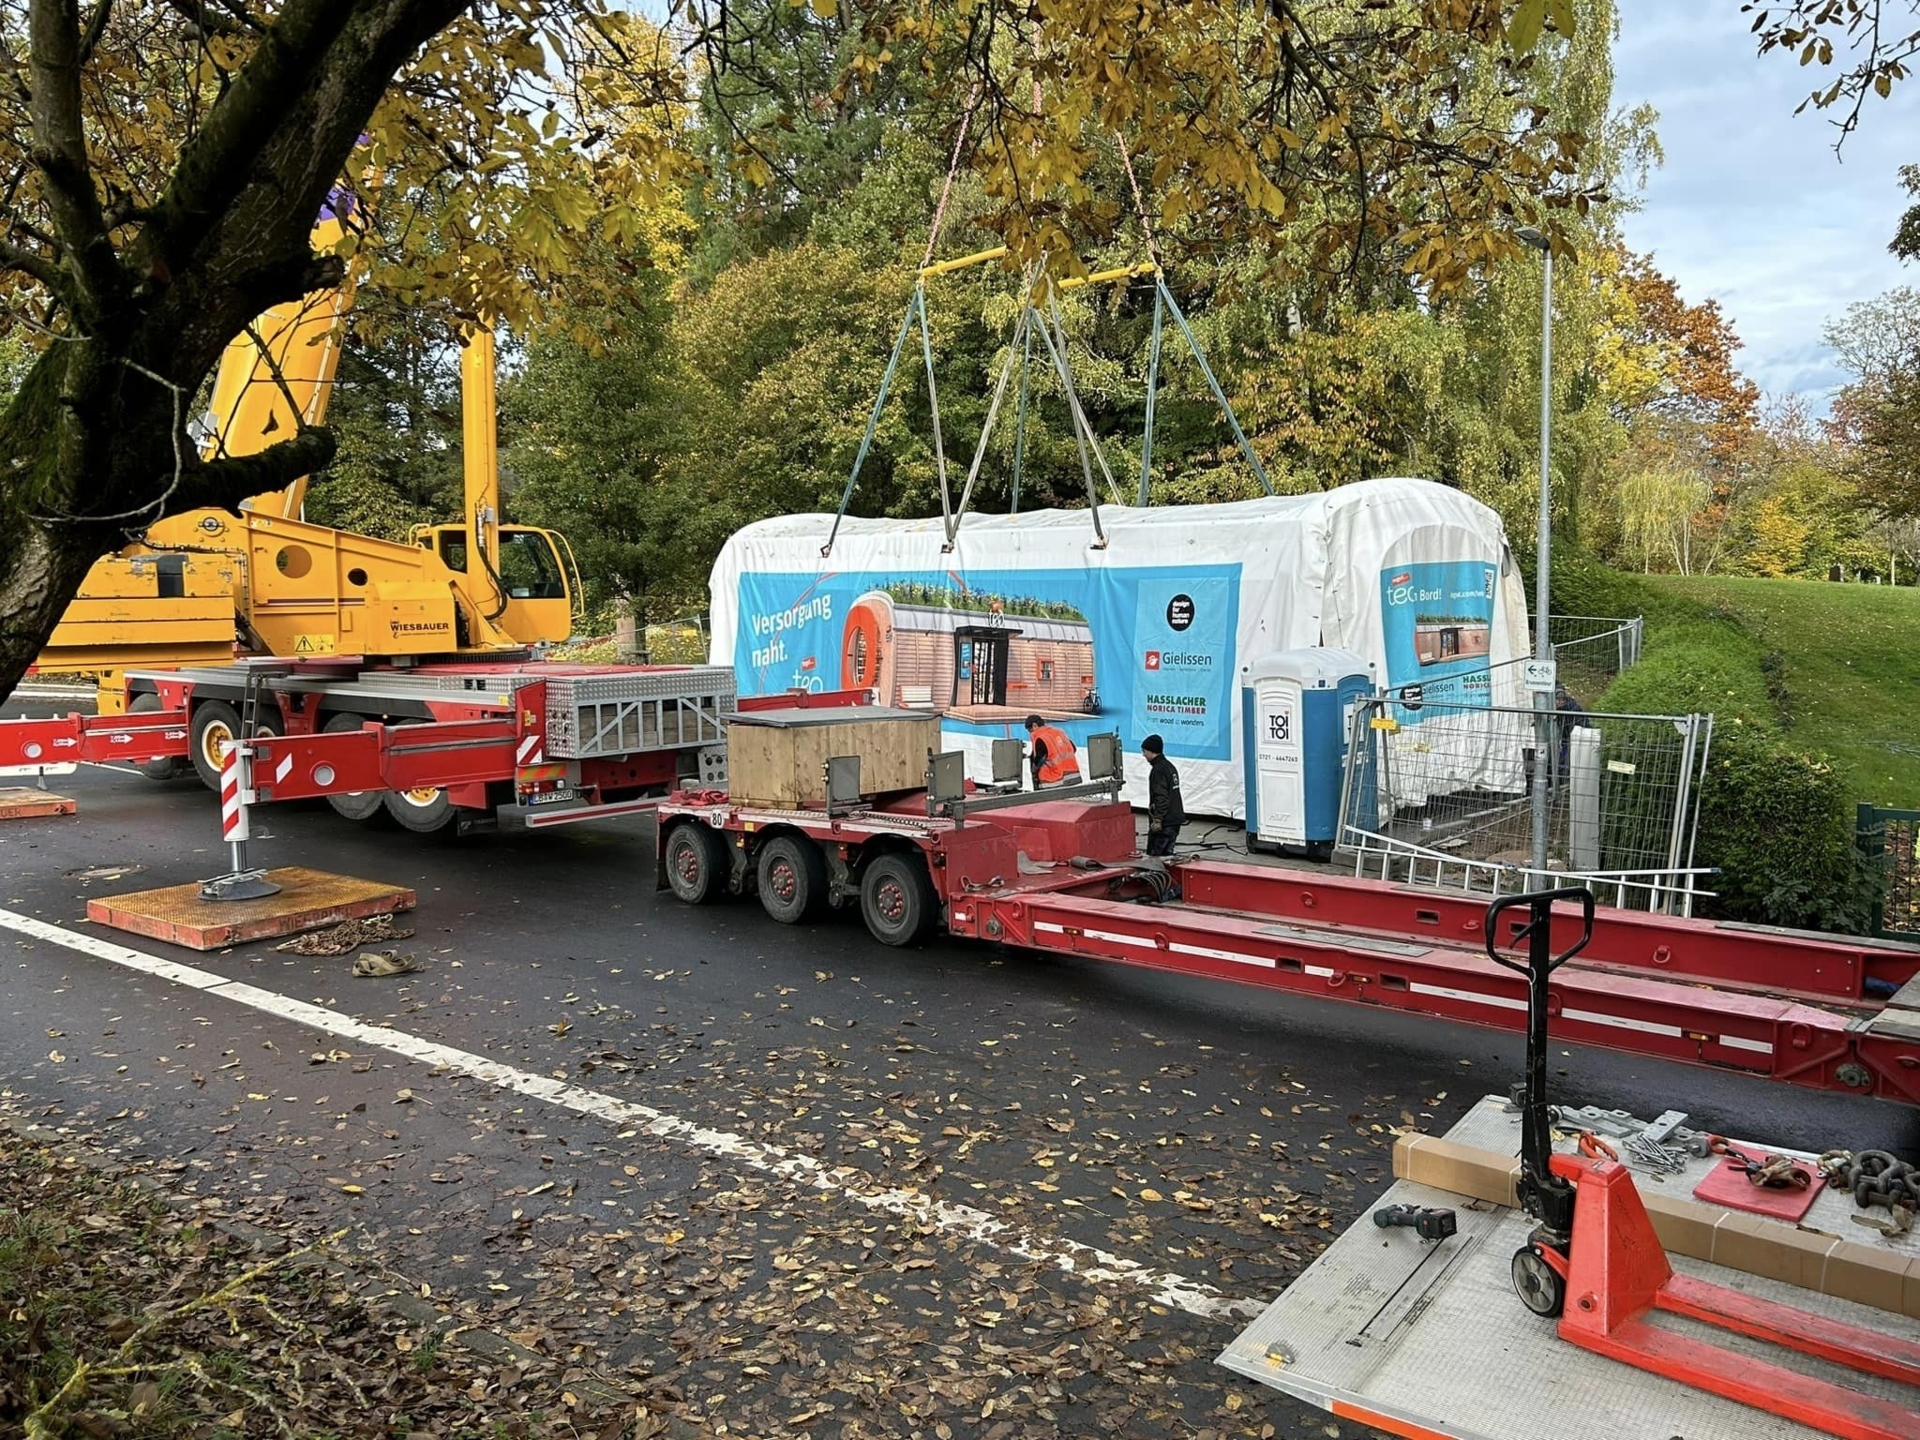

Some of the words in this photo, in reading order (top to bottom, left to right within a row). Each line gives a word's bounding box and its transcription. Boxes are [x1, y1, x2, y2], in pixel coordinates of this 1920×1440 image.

[1420, 588, 1442, 601] Bord!
[752, 594, 832, 637] Versorgung
[390, 622, 449, 631] WIESBAUER
[752, 639, 788, 668] naht.
[1162, 652, 1212, 665] Gielissen
[1147, 694, 1206, 706] HASSLACHER
[1147, 704, 1176, 713] NORICA
[1177, 706, 1206, 714] TIMBER
[1269, 715, 1289, 727] TOI
[1269, 727, 1289, 740] TOI
[712, 812, 723, 826] 80
